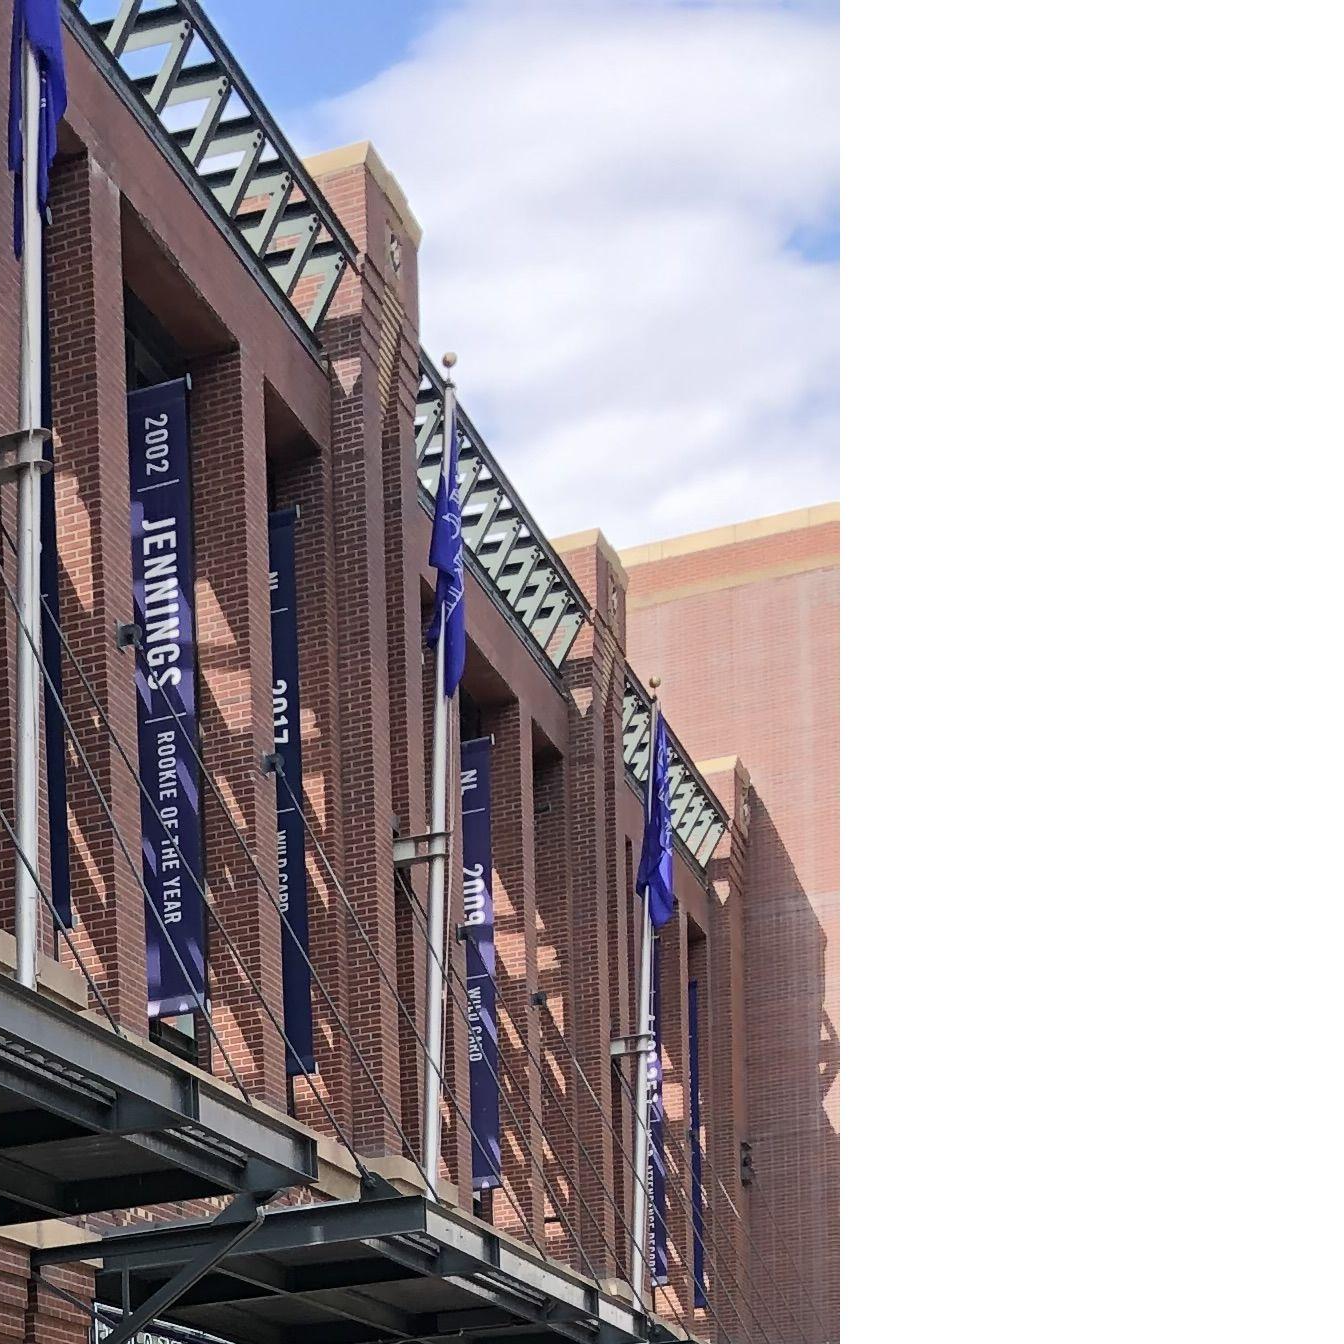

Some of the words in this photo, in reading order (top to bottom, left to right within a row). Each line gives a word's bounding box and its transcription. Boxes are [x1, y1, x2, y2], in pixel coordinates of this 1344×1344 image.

[144, 413, 169, 476] 2002
[141, 516, 182, 691] JENNINGS
[157, 730, 178, 801] ROOKIE
[160, 806, 179, 829] OF
[161, 836, 180, 872] THE
[163, 876, 182, 925] YEAR
[463, 863, 486, 926] 2009
